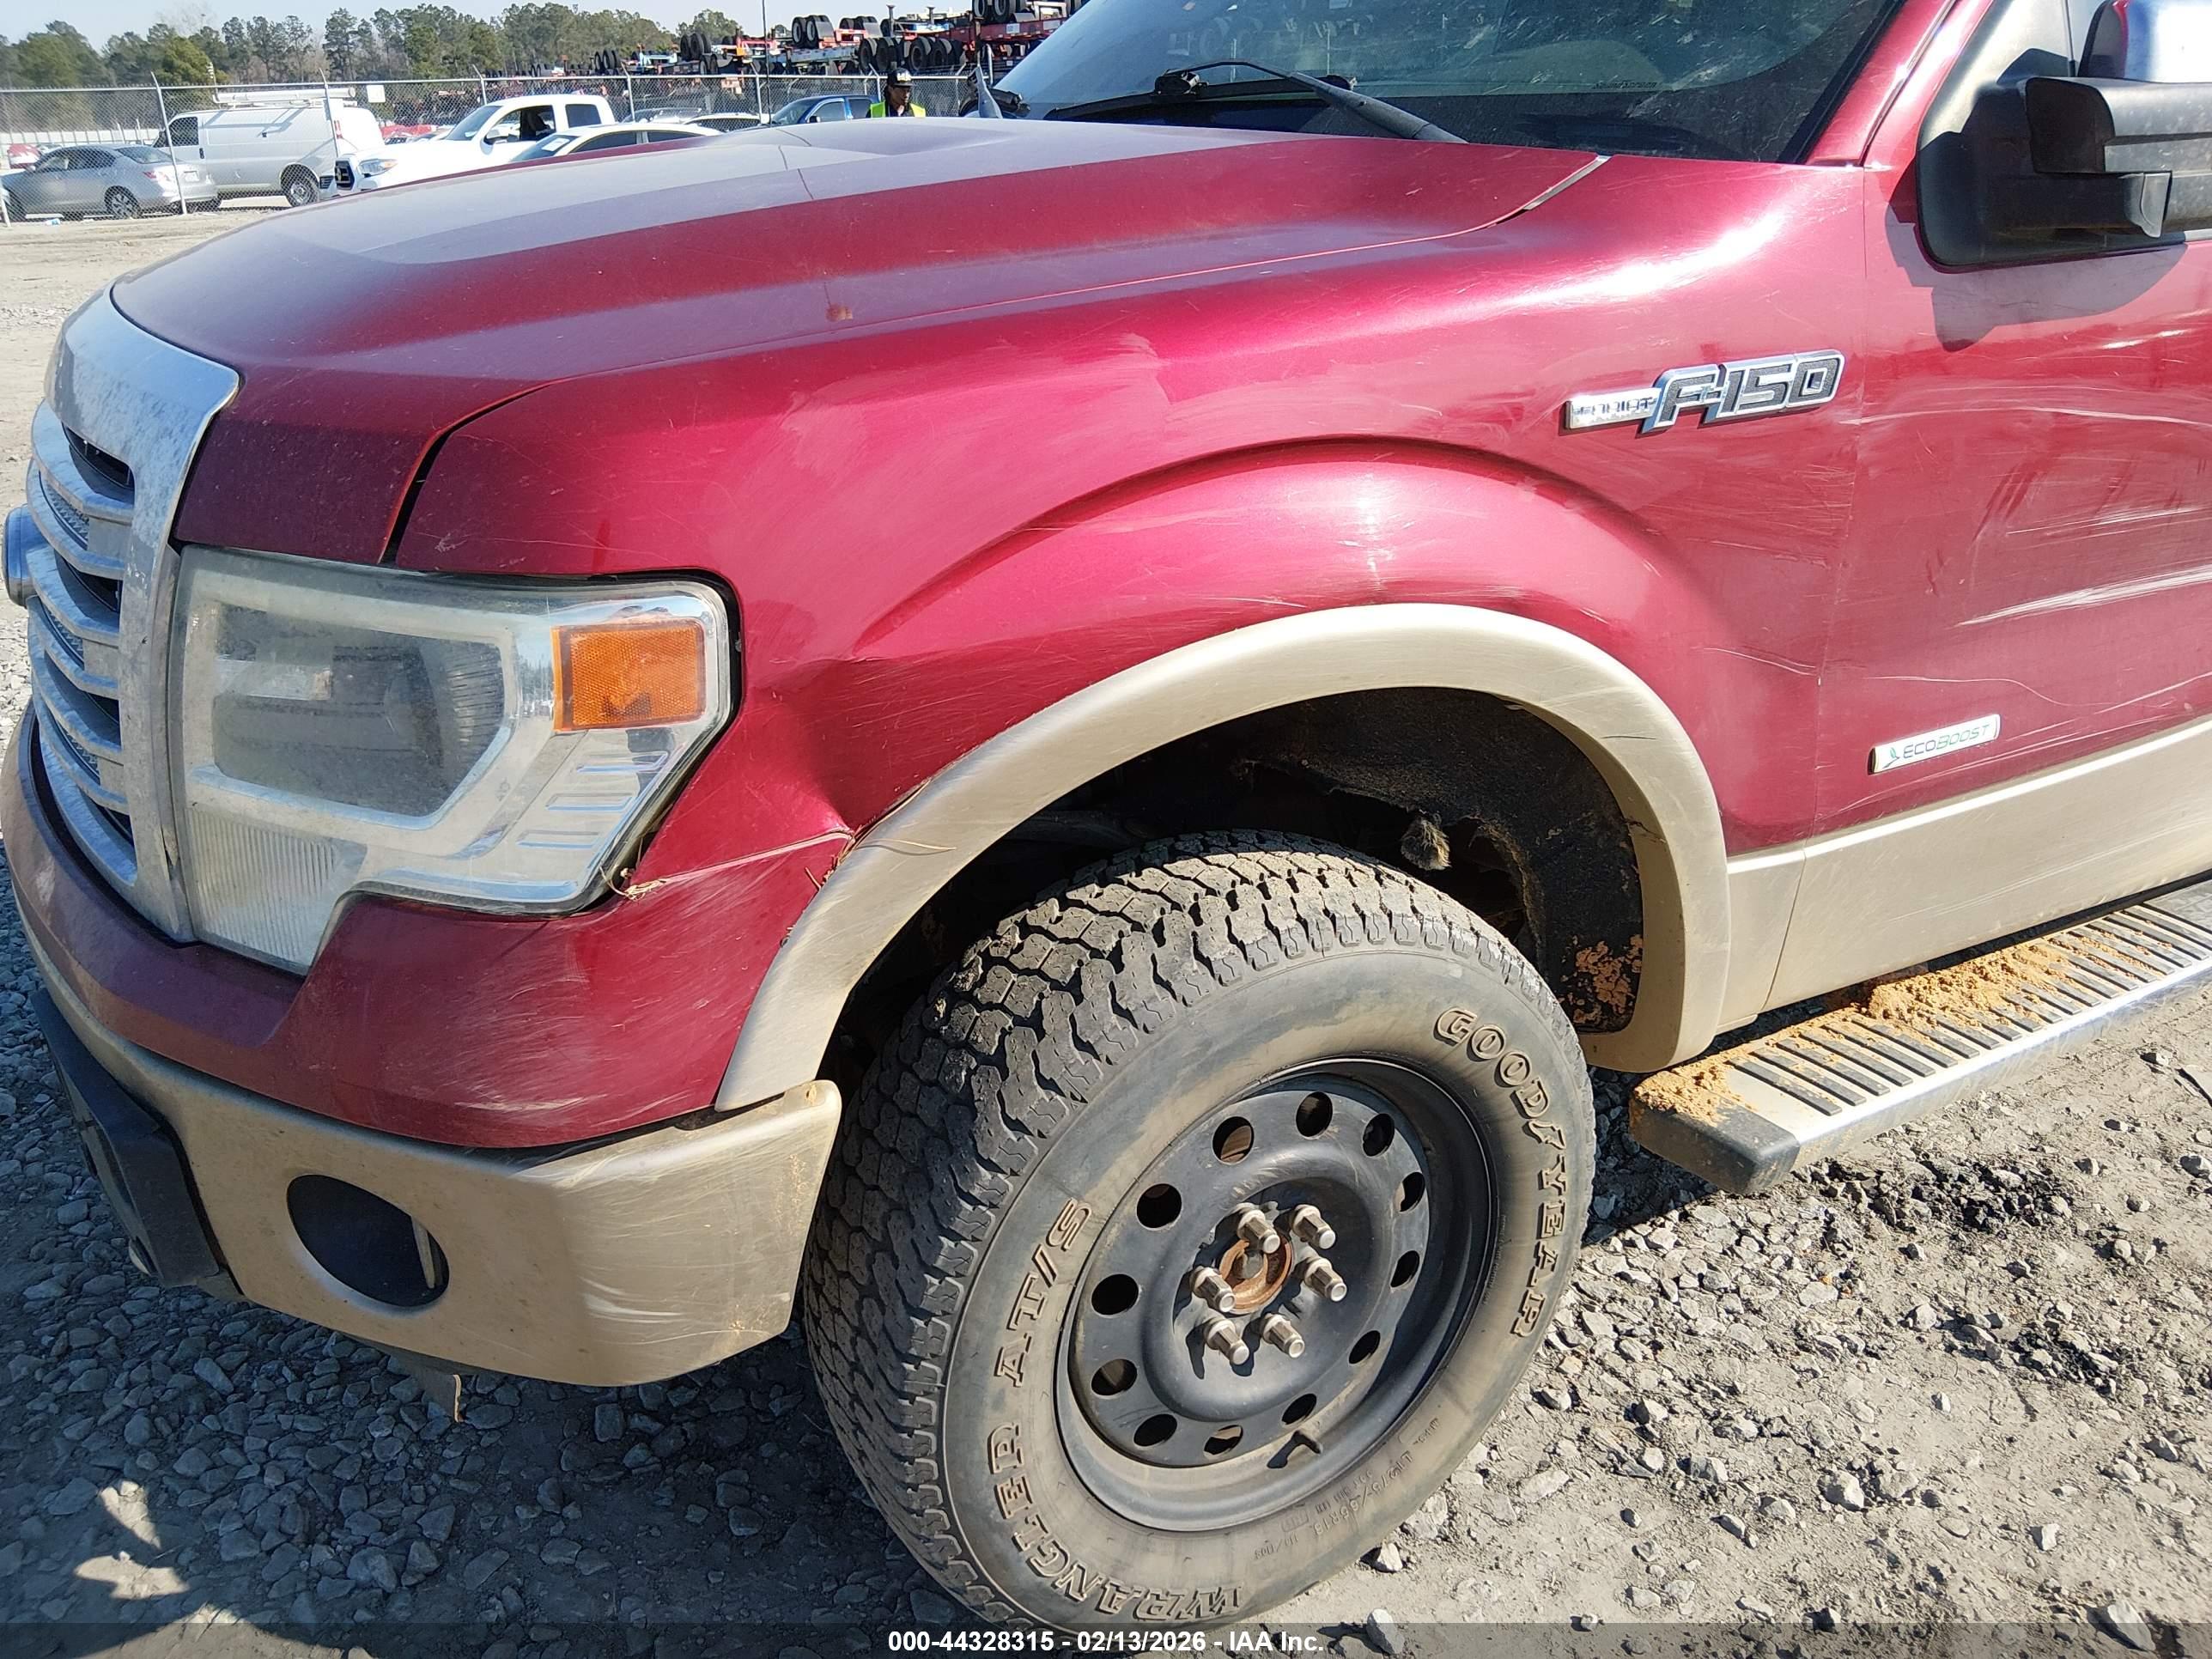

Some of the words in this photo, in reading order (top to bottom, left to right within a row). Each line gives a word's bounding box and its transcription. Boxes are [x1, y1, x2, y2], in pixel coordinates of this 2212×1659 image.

[1641, 349, 1844, 434] F-150
[1903, 724, 1990, 759] ECOBOOST
[1433, 1008, 1567, 1338] GOODYEAR
[993, 1196, 1092, 1388] AT/S
[988, 1422, 1245, 1621] WRANGLER
